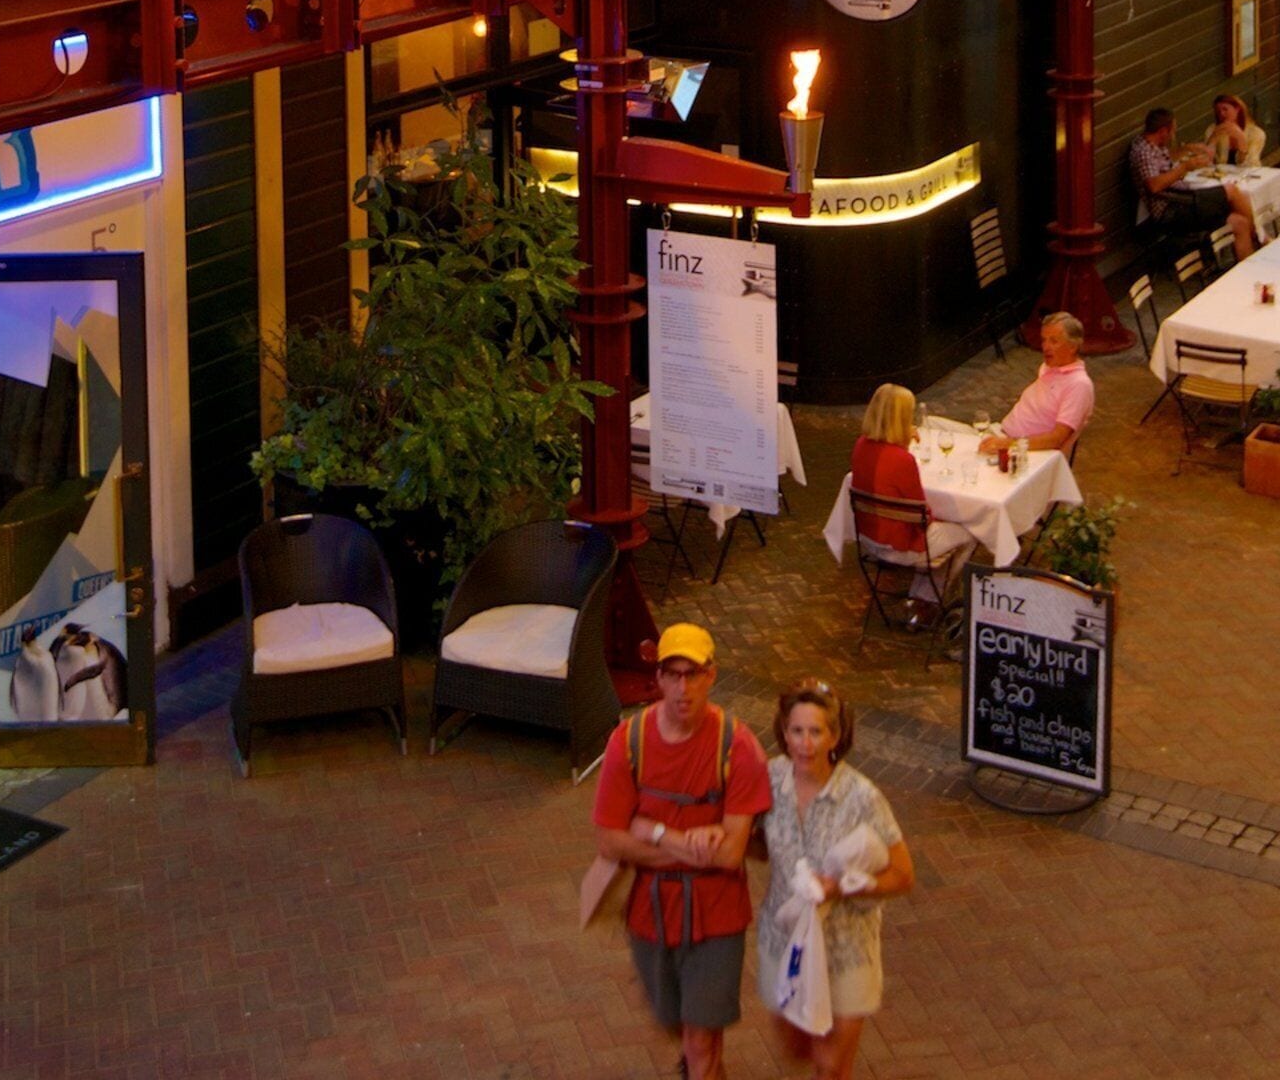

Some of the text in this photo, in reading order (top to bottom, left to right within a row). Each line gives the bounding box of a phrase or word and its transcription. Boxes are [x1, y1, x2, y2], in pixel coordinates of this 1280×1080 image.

[906, 190, 916, 206] &
[920, 173, 948, 201] GRILL
[658, 239, 704, 275] finz
[980, 577, 1026, 616] finz
[1045, 638, 1088, 675] bird
[990, 676, 1036, 708] $20
[1047, 714, 1092, 749] chips
